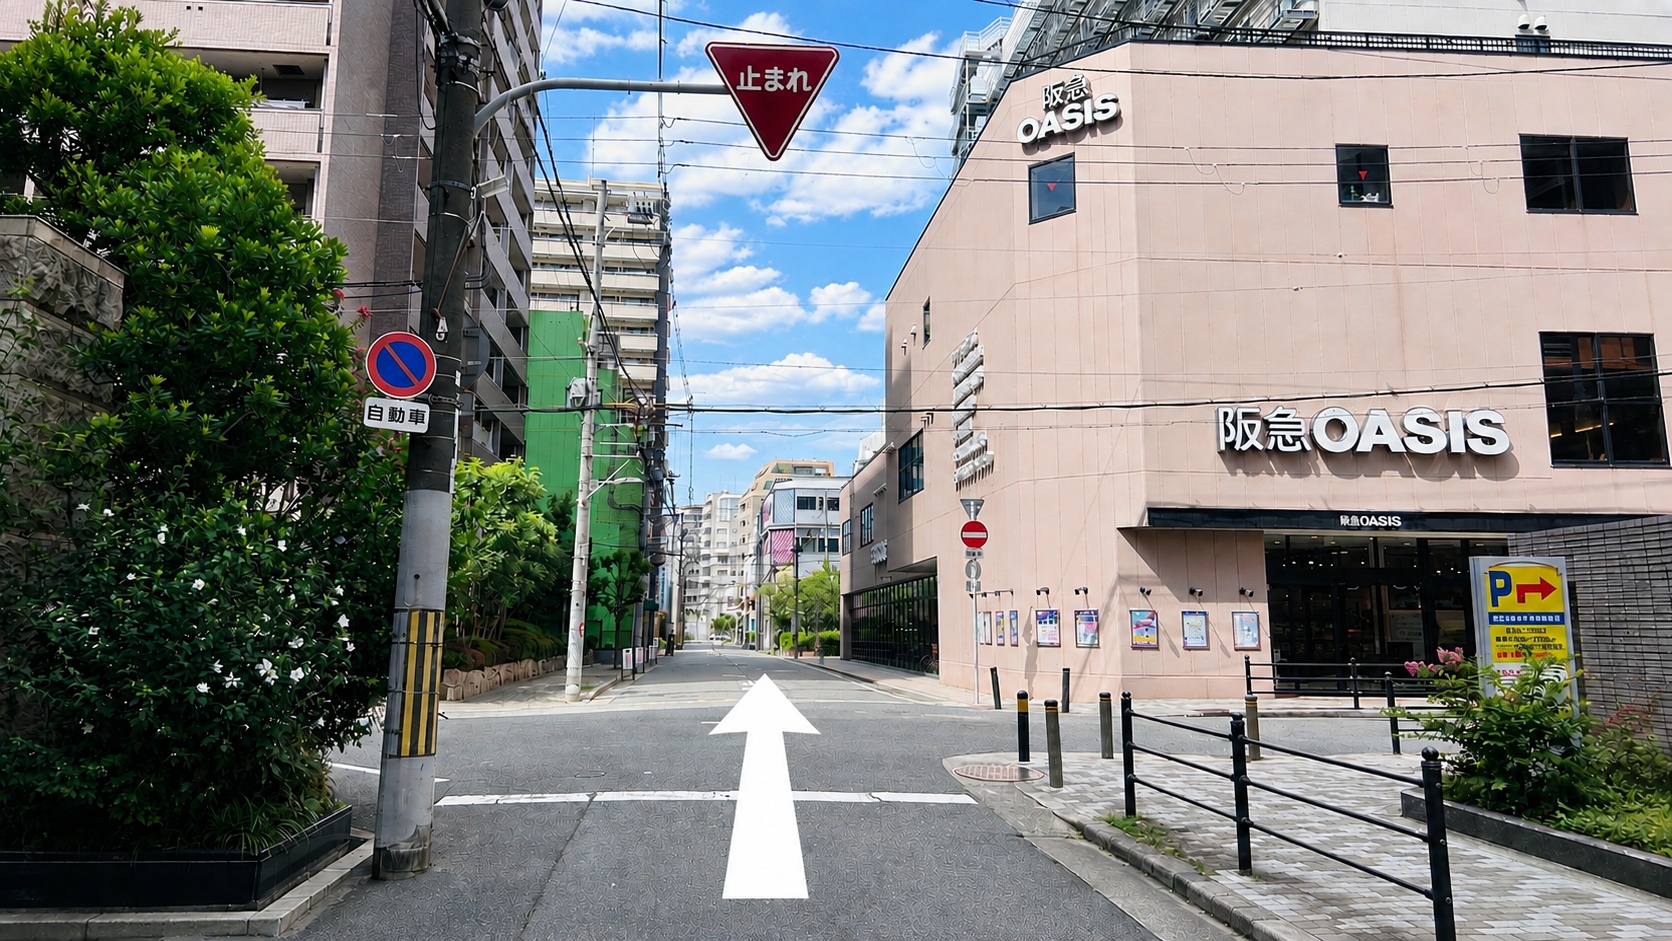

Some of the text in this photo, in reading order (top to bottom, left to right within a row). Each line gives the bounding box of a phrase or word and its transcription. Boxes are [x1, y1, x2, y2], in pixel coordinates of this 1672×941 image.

[736, 65, 812, 93] 止まれ
[1042, 74, 1090, 109] 阪急
[1016, 93, 1119, 144] OASIS
[367, 404, 427, 426] 自動車
[1216, 406, 1511, 456] 阪急OASIS
[1488, 570, 1513, 608] P
